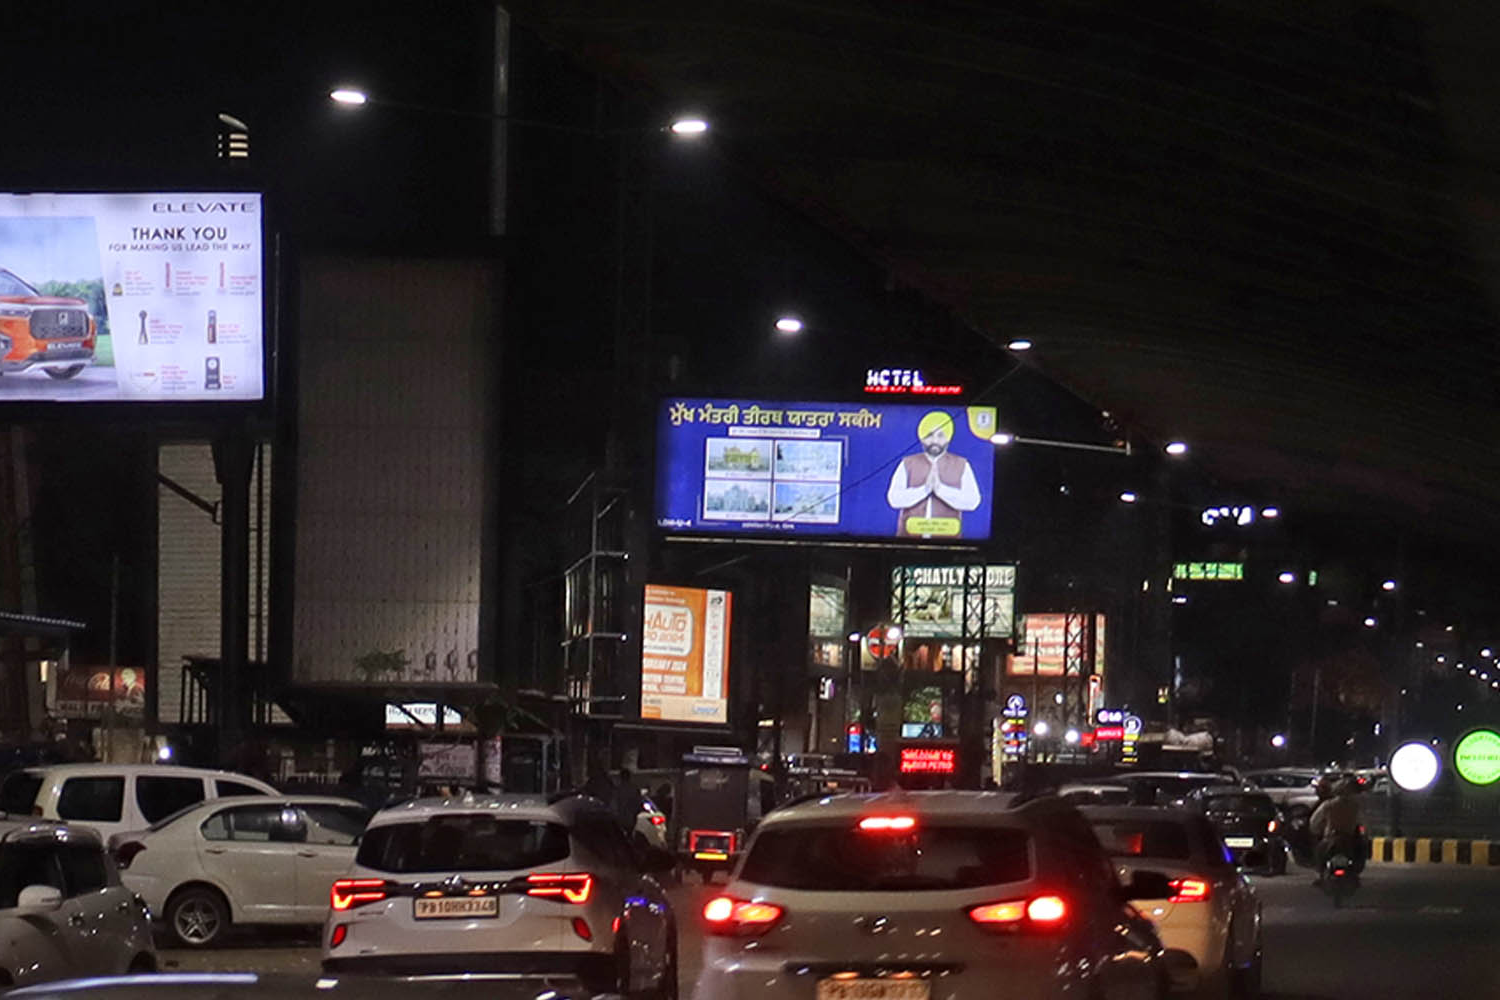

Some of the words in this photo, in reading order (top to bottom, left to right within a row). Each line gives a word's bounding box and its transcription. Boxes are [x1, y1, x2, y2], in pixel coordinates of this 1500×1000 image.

[152, 202, 256, 213] ELEVATE
[132, 226, 186, 241] THANK
[192, 226, 228, 241] YOU
